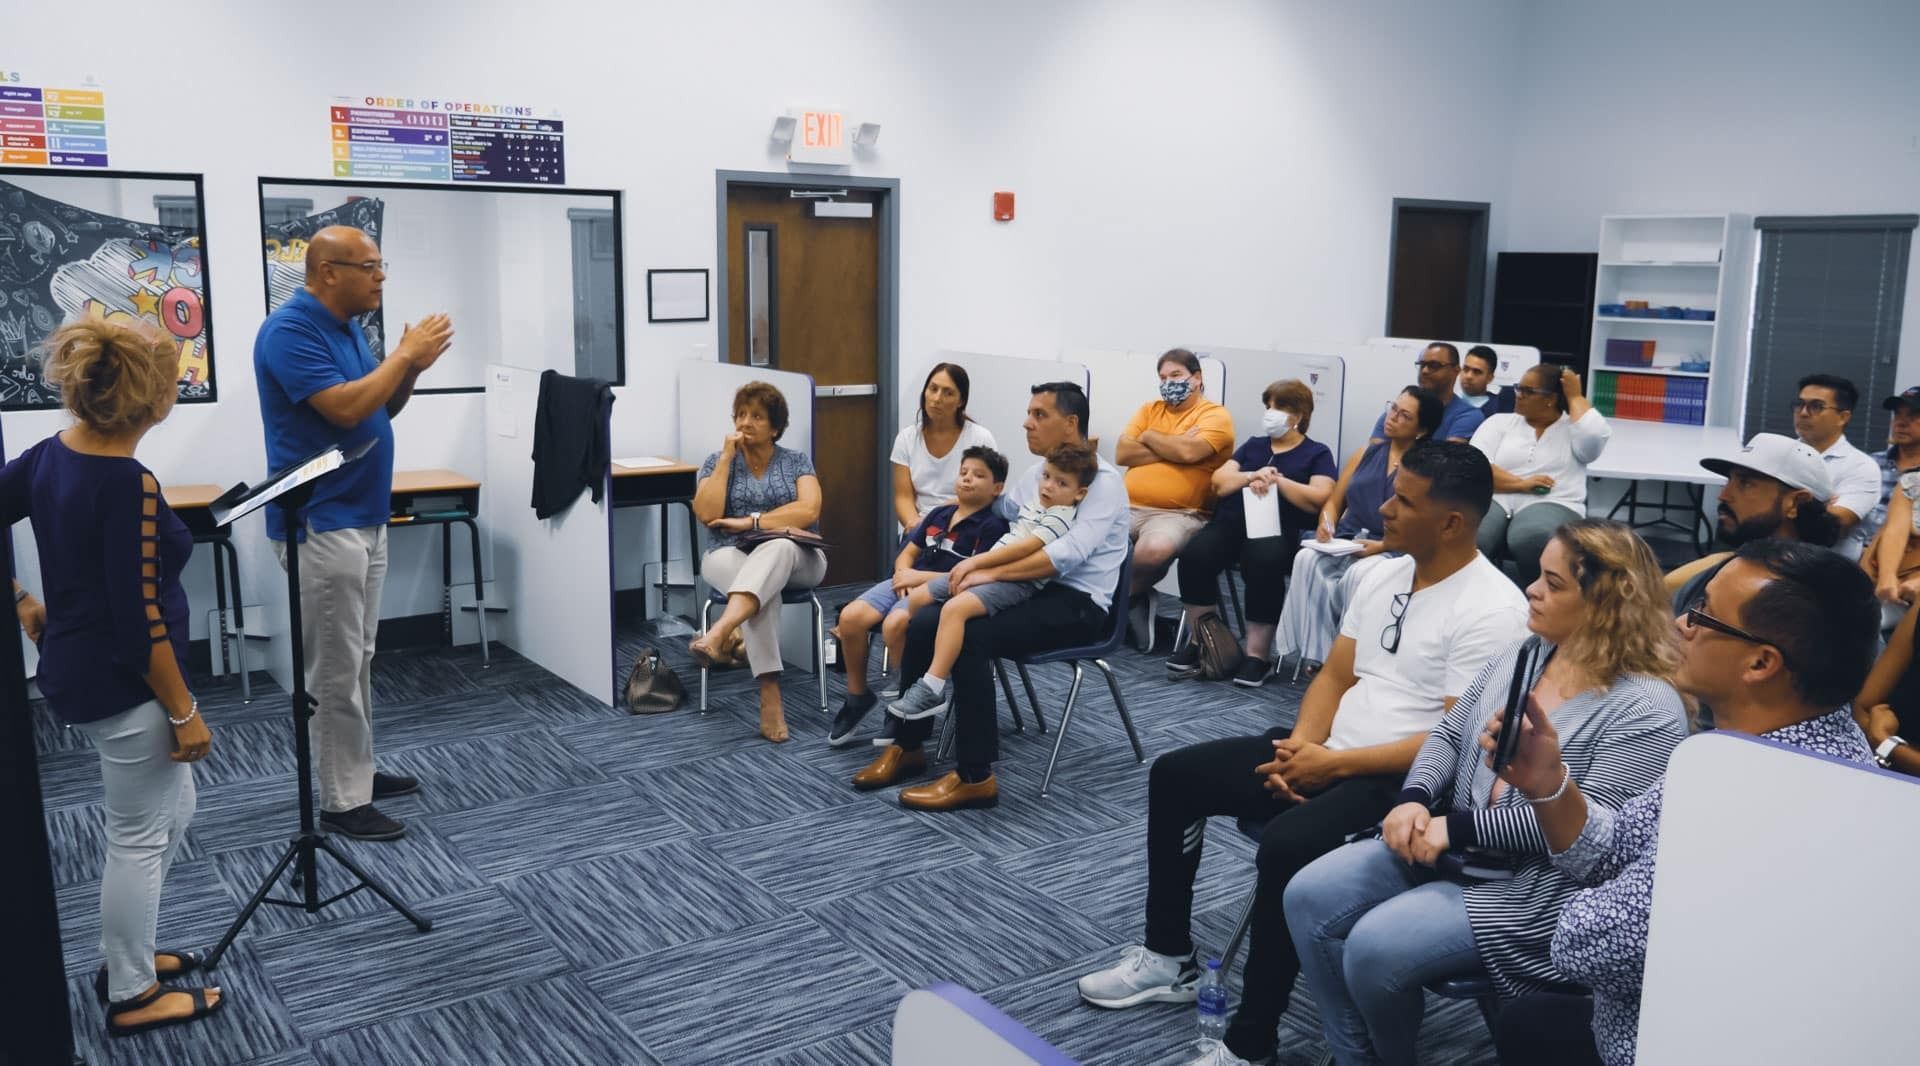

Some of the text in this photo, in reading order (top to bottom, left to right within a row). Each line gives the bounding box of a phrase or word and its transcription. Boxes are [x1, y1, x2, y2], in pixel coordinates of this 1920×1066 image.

[365, 97, 532, 116] ORDER OF OPERATIONS
[804, 111, 842, 148] EXIT
